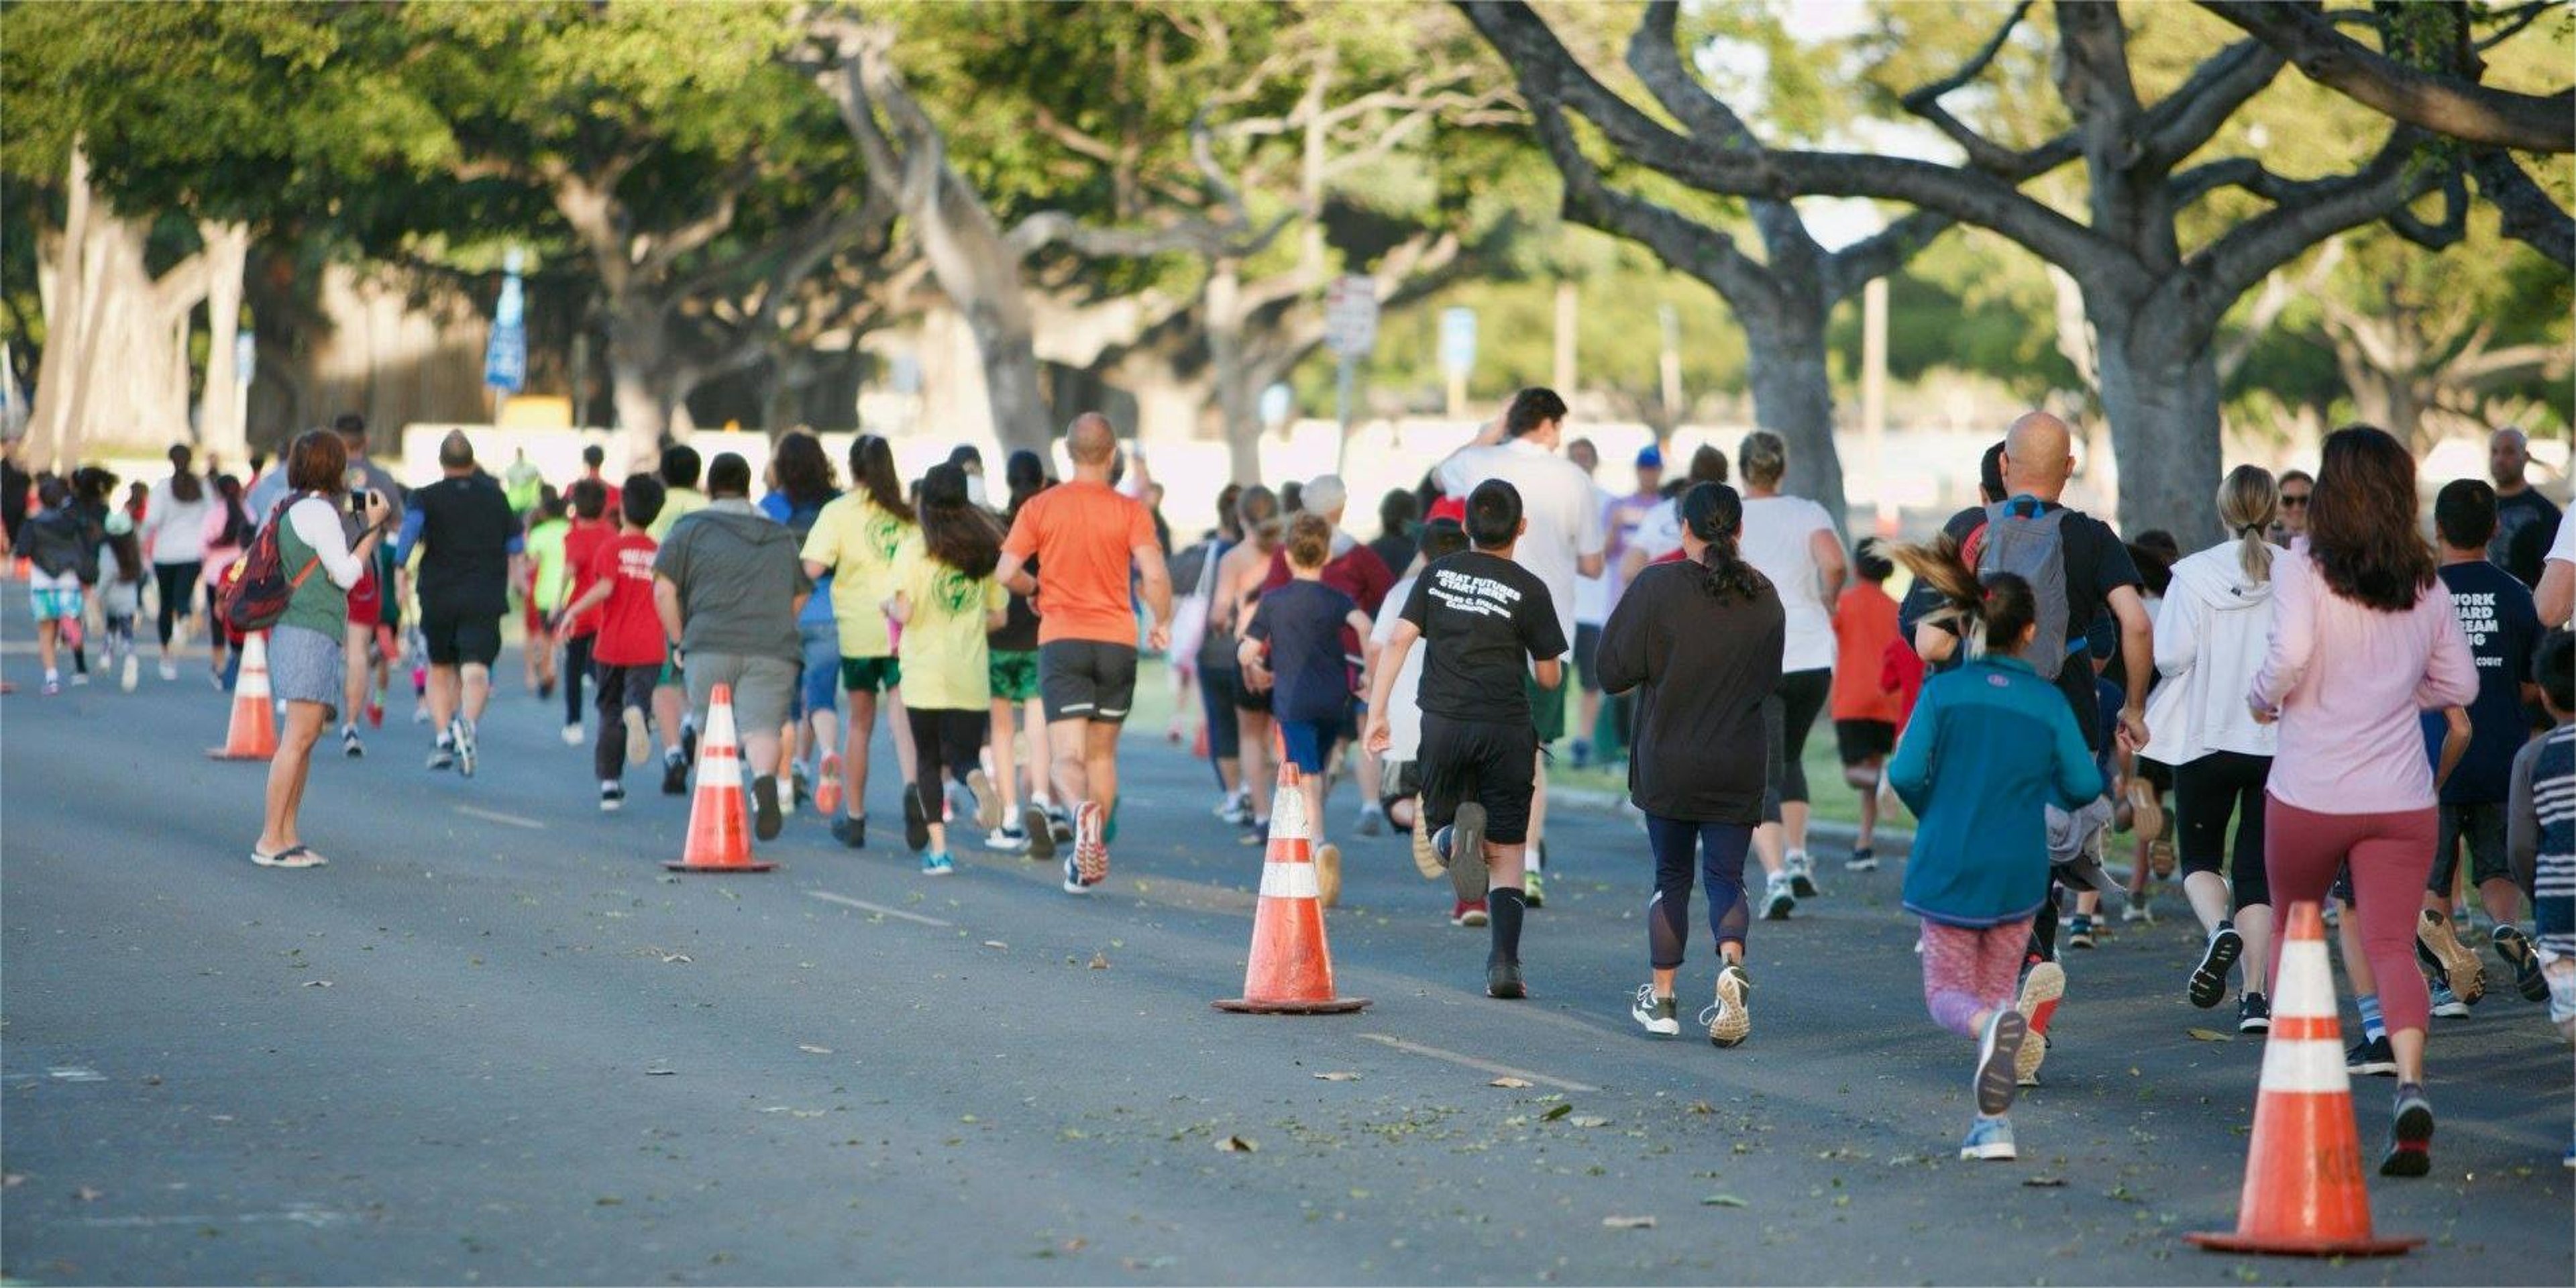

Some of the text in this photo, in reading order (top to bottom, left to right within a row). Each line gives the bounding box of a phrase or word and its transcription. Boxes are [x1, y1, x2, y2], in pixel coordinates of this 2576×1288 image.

[1440, 577, 1476, 594] START
[1472, 577, 1521, 601] FUTURES
[2460, 619, 2498, 633] EAM
[2467, 633, 2486, 646] IG
